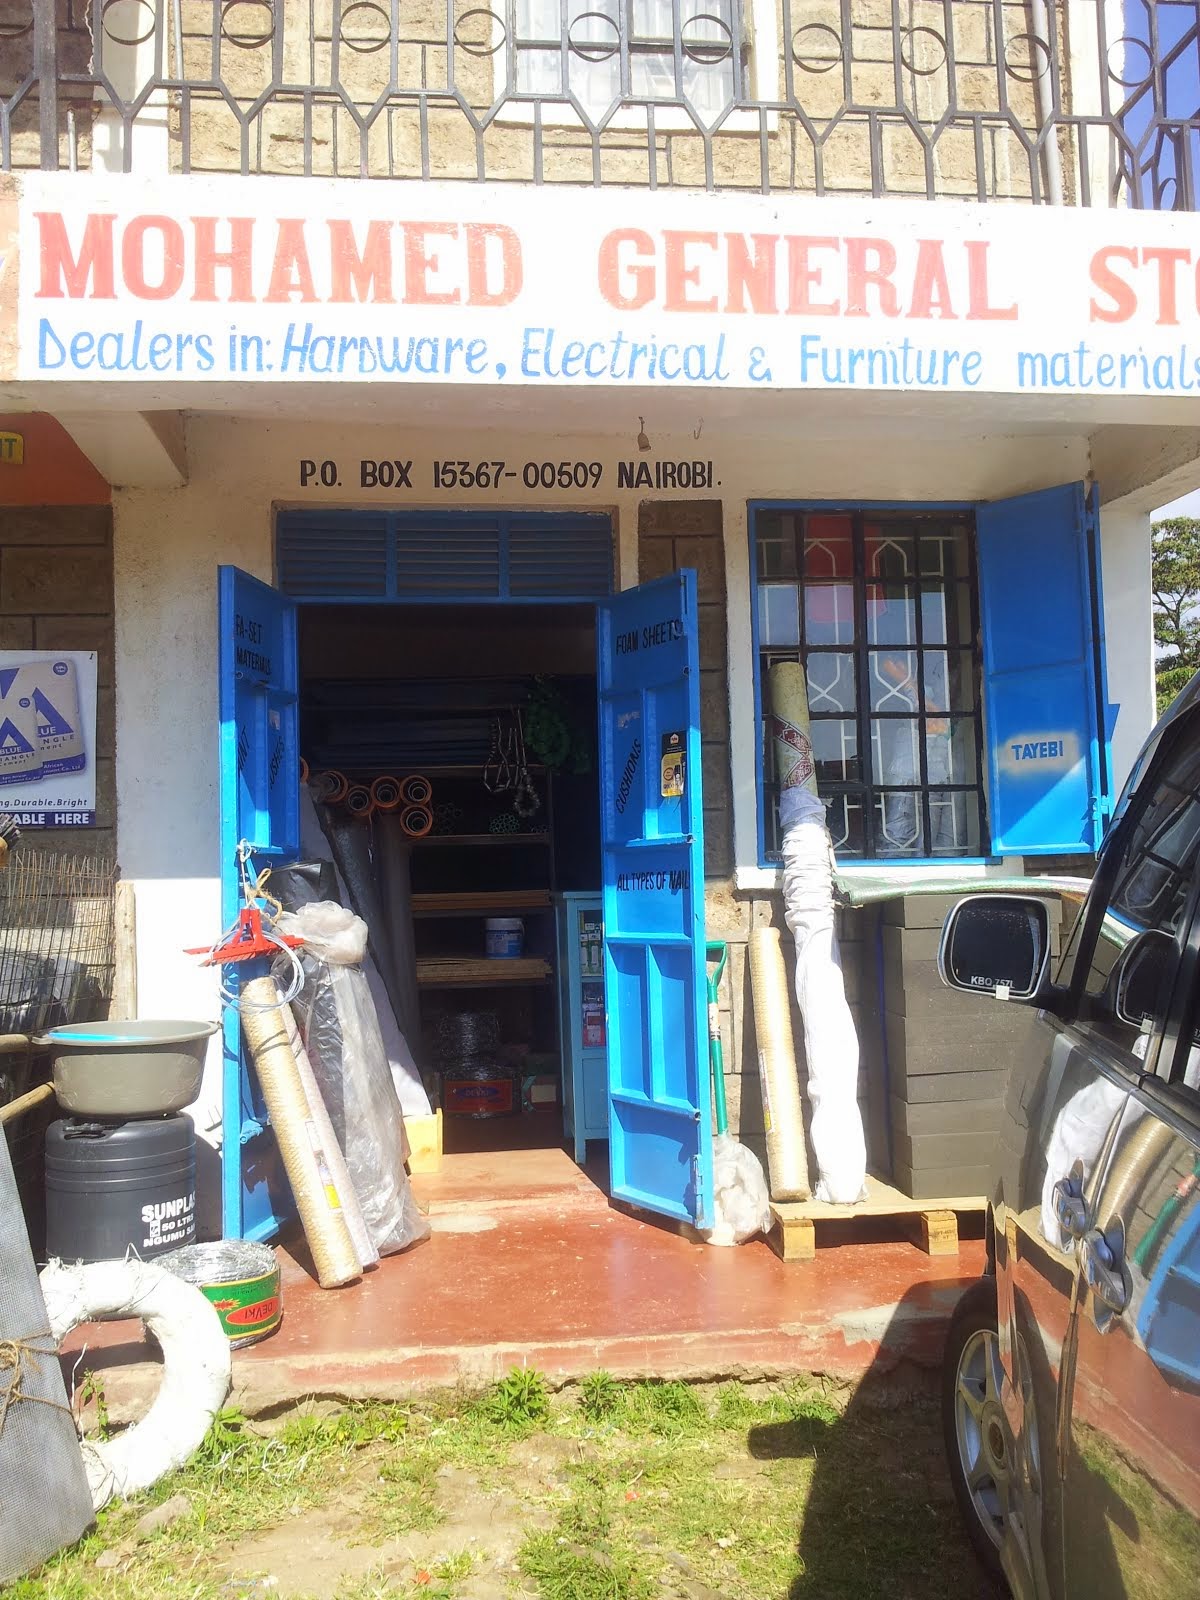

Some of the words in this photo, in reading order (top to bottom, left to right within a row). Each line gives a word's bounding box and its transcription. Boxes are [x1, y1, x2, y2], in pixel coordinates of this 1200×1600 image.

[33, 211, 523, 307] MOHAMED
[600, 227, 1018, 321] GENERAL
[1089, 245, 1200, 326] ST
[38, 318, 215, 371] Dealers
[229, 324, 273, 372] in:
[522, 327, 730, 380] Electrical
[748, 345, 772, 383] &
[800, 334, 983, 386] Furniture
[300, 460, 343, 488] P.O.
[360, 460, 413, 488] BOX
[433, 460, 603, 489] 15367-00509
[617, 460, 722, 489] NAIROBI.
[615, 630, 639, 656] FOAM
[1011, 740, 1064, 761] TAYEBI
[615, 738, 642, 815] CUSHIONS
[54, 813, 90, 825] HERE
[616, 873, 630, 891] ALL
[631, 871, 655, 891] TYPES
[656, 871, 667, 890] OF
[970, 975, 993, 987] KBQ
[161, 1221, 176, 1232] 50
[244, 1302, 273, 1320] DEVKI
